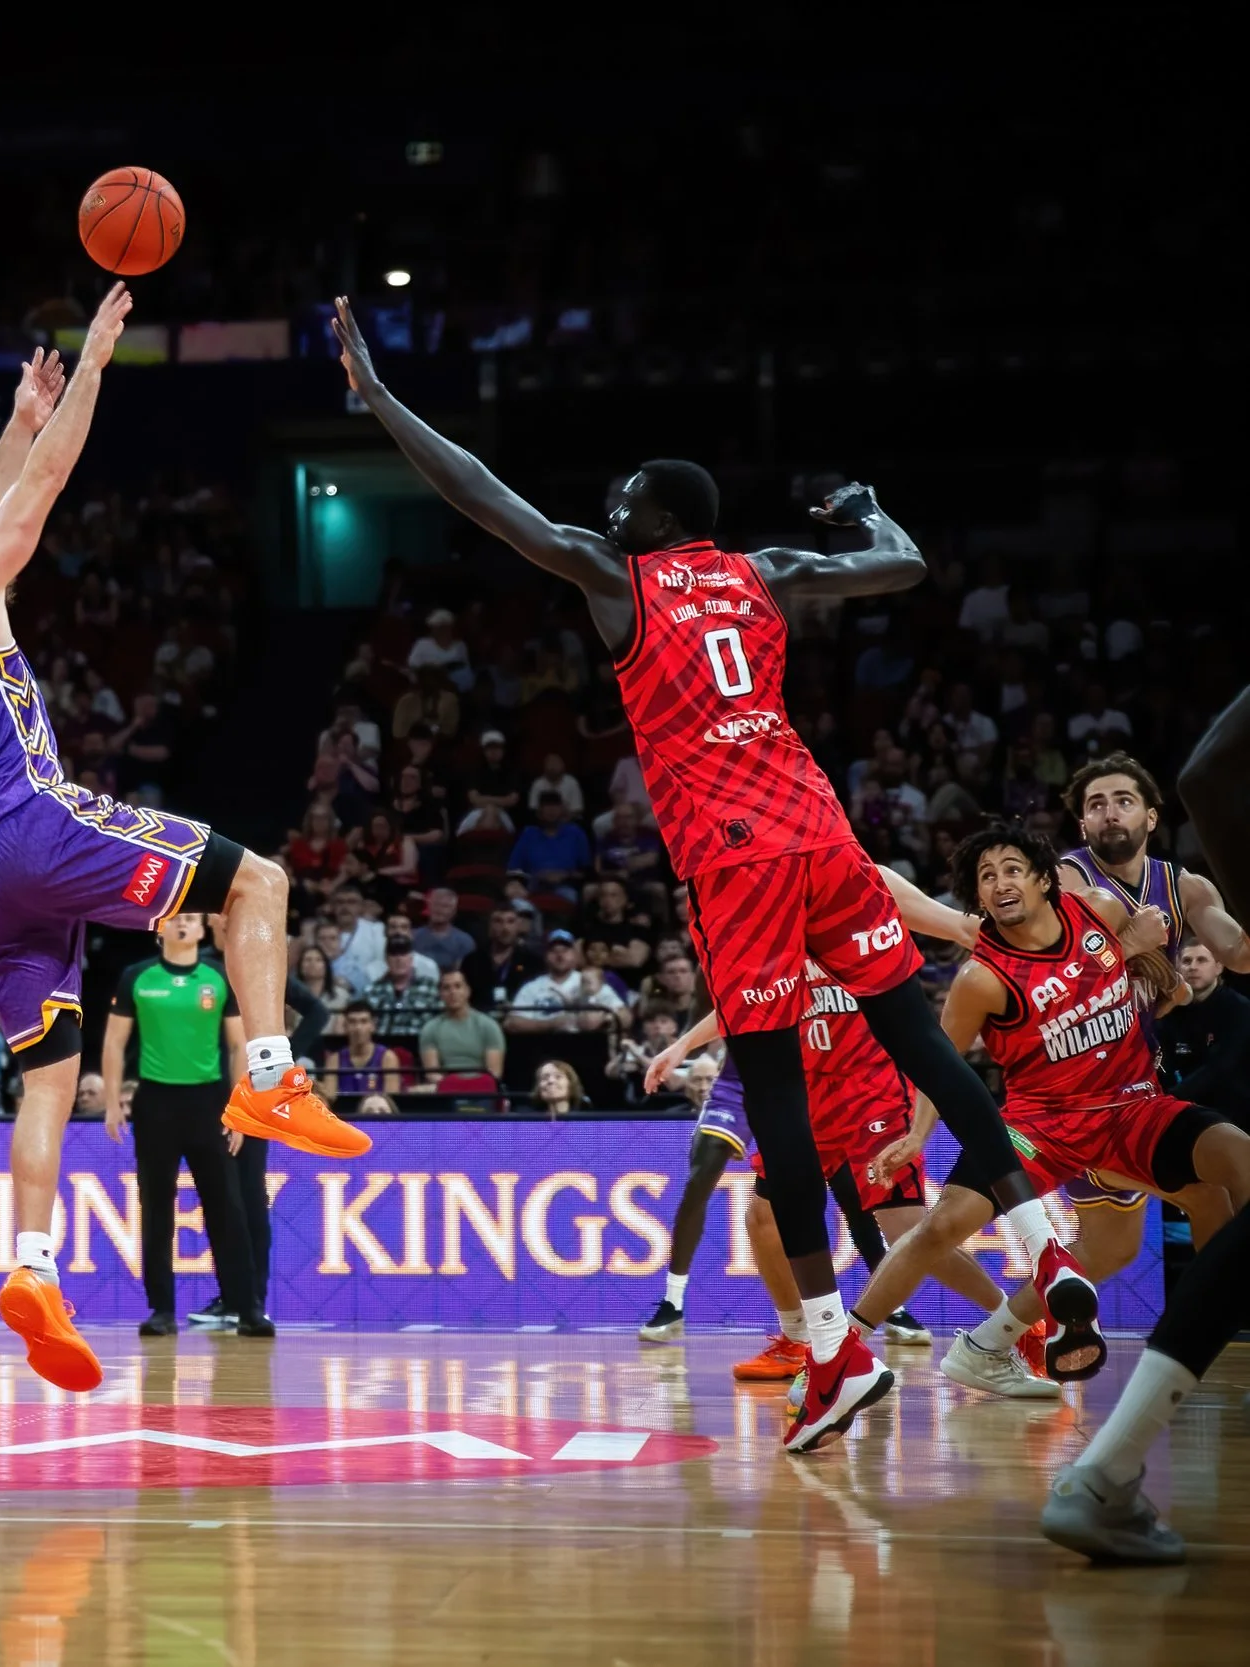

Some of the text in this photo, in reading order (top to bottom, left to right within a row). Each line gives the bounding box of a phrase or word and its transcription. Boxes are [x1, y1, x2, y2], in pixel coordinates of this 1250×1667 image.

[737, 600, 754, 616] JR.
[704, 627, 754, 698] 0
[717, 716, 771, 738] NRW
[132, 857, 164, 902] AAMI
[1045, 1000, 1134, 1062] WILDCATS
[315, 1171, 672, 1280] KINGS
